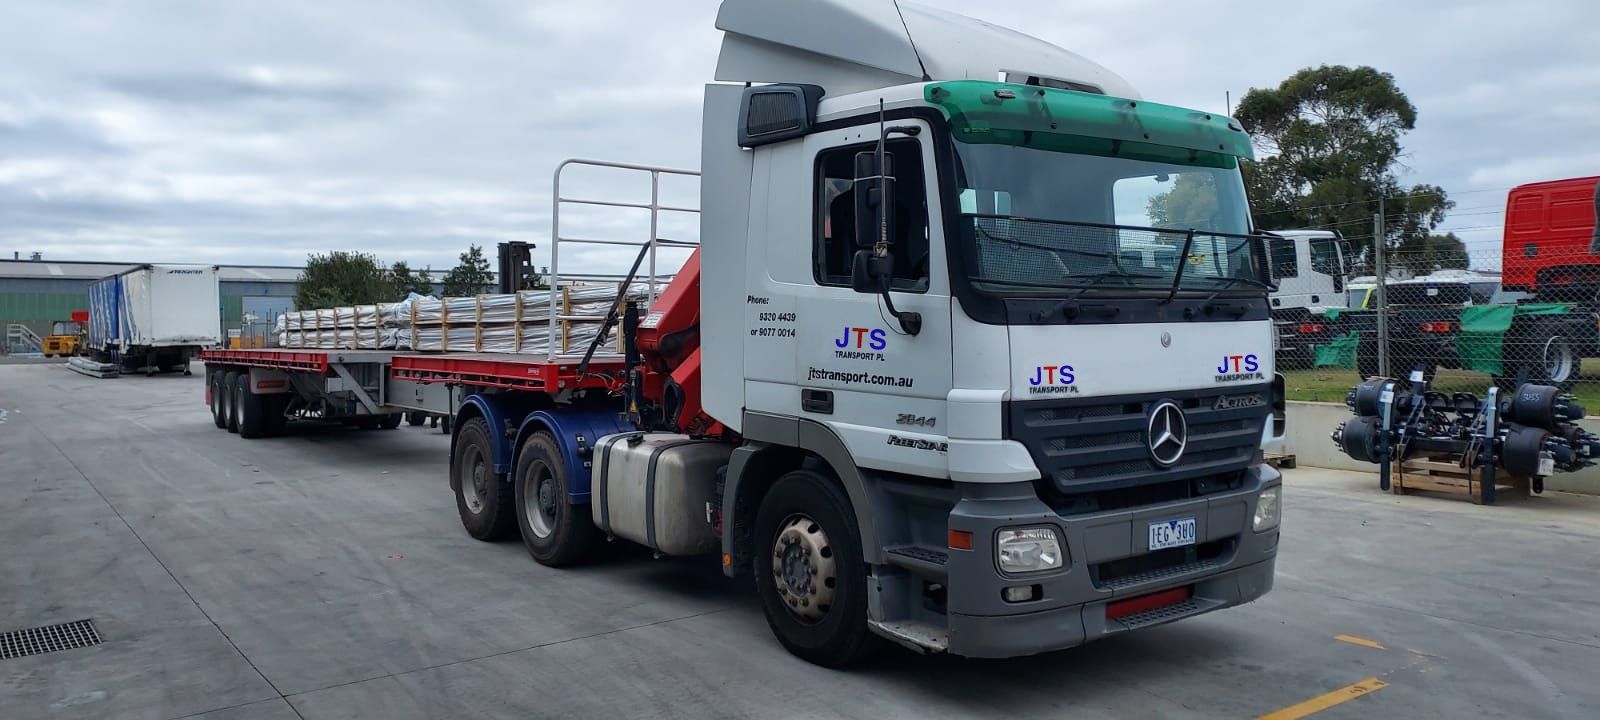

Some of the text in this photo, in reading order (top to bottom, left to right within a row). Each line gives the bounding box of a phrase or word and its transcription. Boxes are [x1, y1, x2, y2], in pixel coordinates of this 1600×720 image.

[747, 295, 769, 305] Phone:
[777, 313, 796, 322] 4439
[759, 327, 776, 337] 9077
[777, 328, 796, 338] 0014
[835, 327, 887, 351] JTS
[835, 350, 886, 362] TRANSPORT PL
[1217, 354, 1259, 374] JTS
[807, 366, 914, 388] jtstransport.com.au
[1029, 365, 1075, 386] JTS
[1215, 372, 1265, 383] TRANSPORT PL
[1029, 386, 1068, 395] TRANSPORT
[896, 413, 936, 428] 2844
